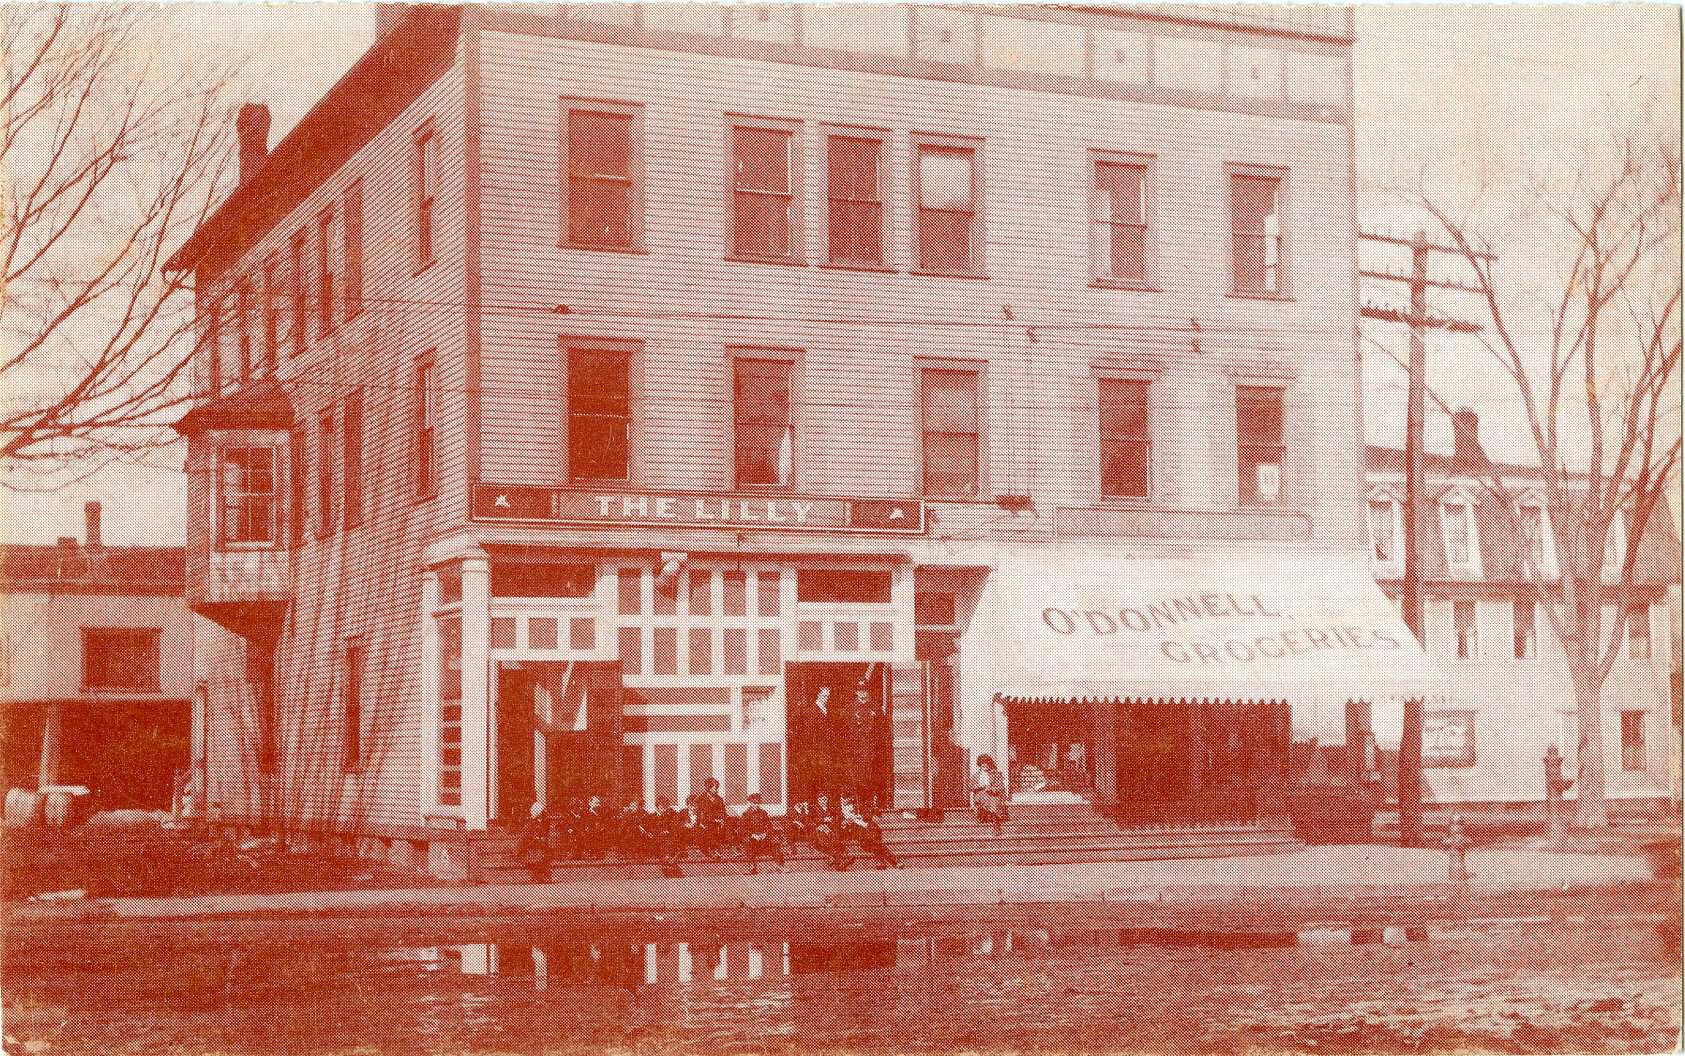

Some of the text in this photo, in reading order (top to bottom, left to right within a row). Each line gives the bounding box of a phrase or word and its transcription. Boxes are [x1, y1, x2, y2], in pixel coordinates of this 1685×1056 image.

[598, 496, 812, 524] THE LILLY
[1162, 626, 1400, 664] GROCERIES
